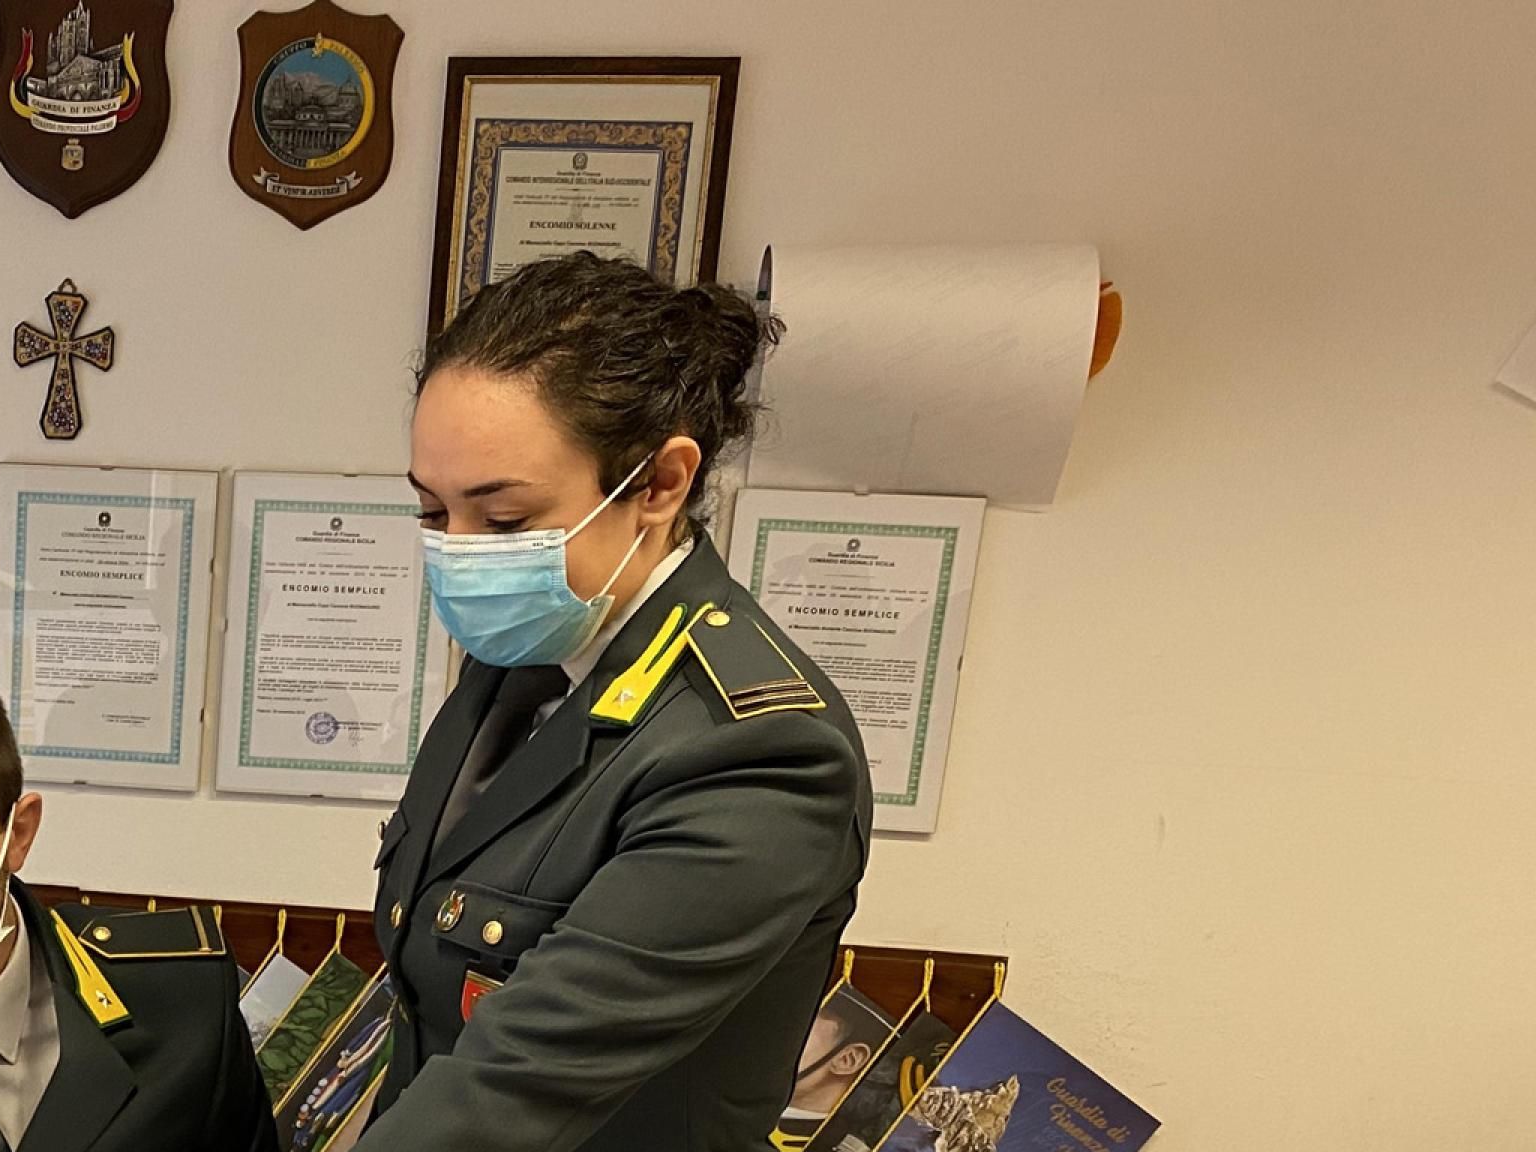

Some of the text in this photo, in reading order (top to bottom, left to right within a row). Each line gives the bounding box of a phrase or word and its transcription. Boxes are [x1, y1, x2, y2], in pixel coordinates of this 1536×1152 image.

[60, 570, 143, 580] ENCOMIO SEMPLICE
[282, 584, 385, 595] ENCOMIO SEMPLICE
[788, 605, 901, 619] ENCOMIO SEMPLICE
[1046, 1077, 1131, 1143] Guardia di
